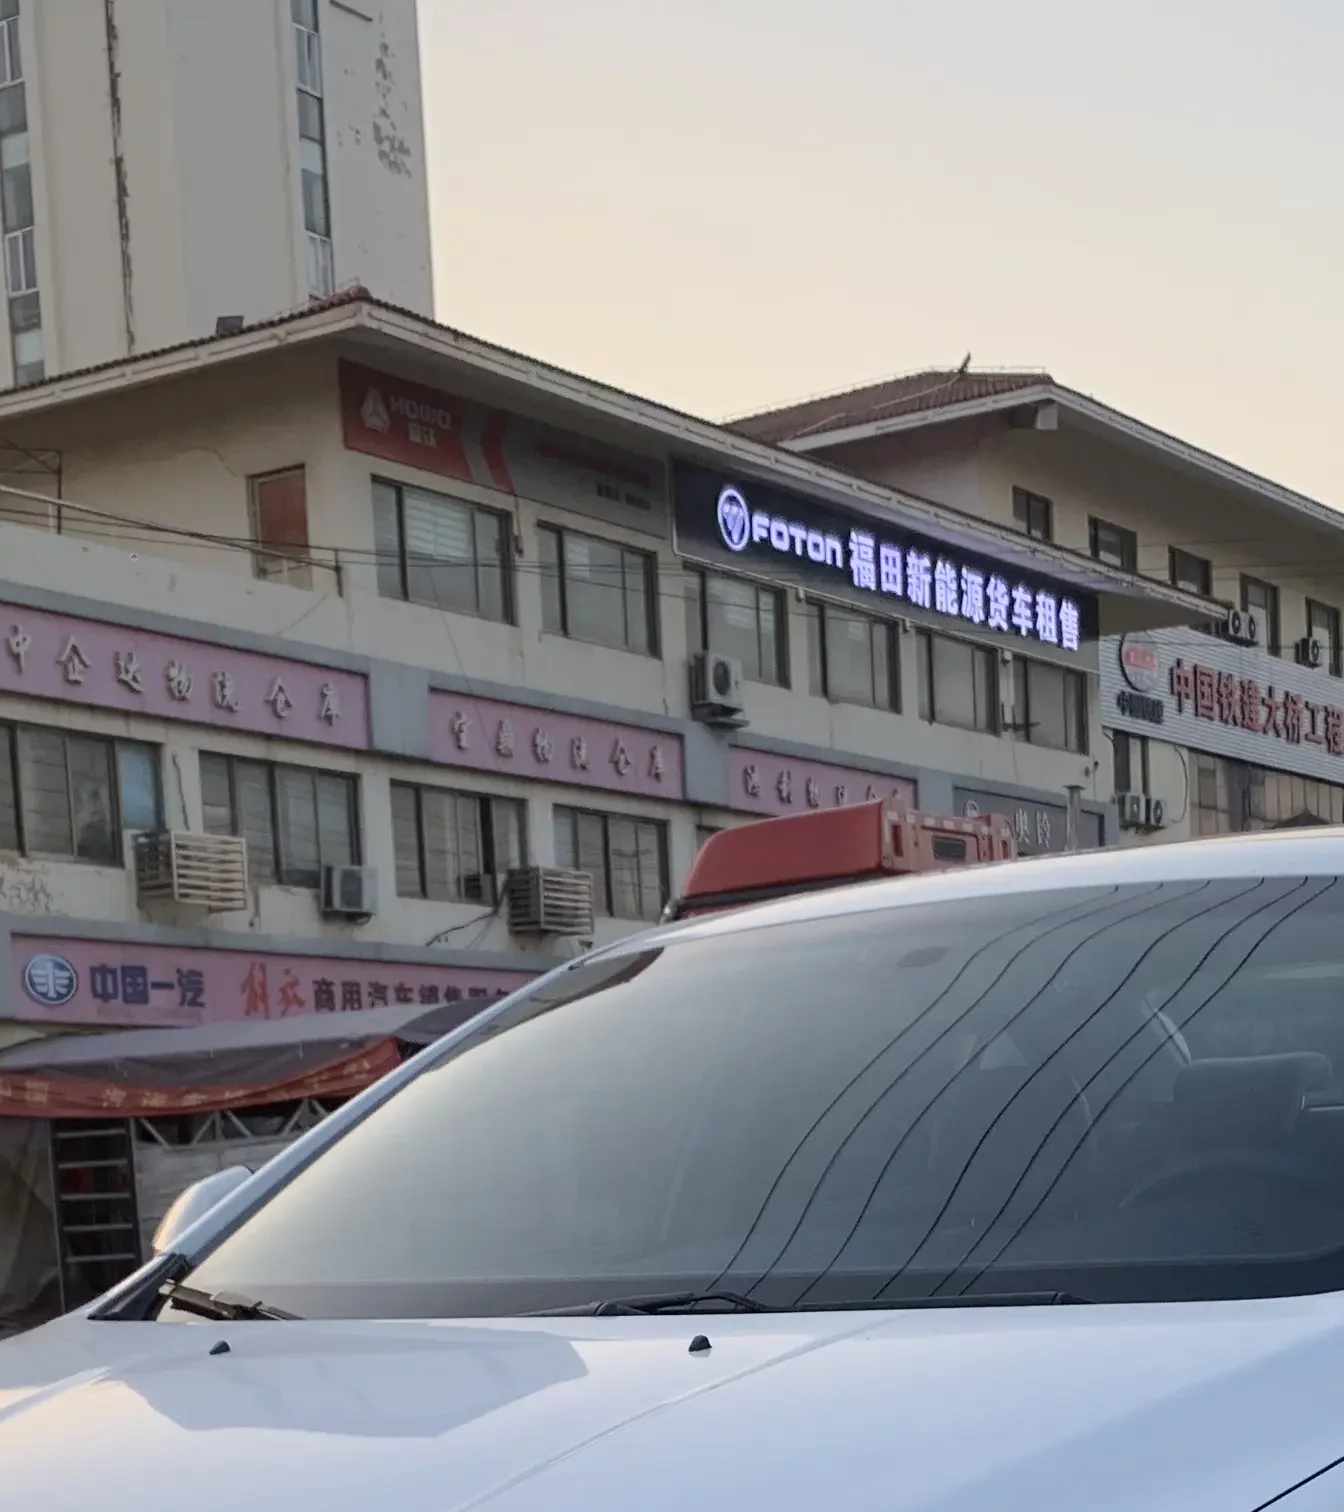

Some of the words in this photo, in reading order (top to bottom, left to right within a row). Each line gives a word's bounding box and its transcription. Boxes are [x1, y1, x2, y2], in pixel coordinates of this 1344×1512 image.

[752, 513, 844, 569] FOTON
[848, 530, 1080, 652] 福田新能源货车租售
[89, 963, 205, 1009] 中国一汽
